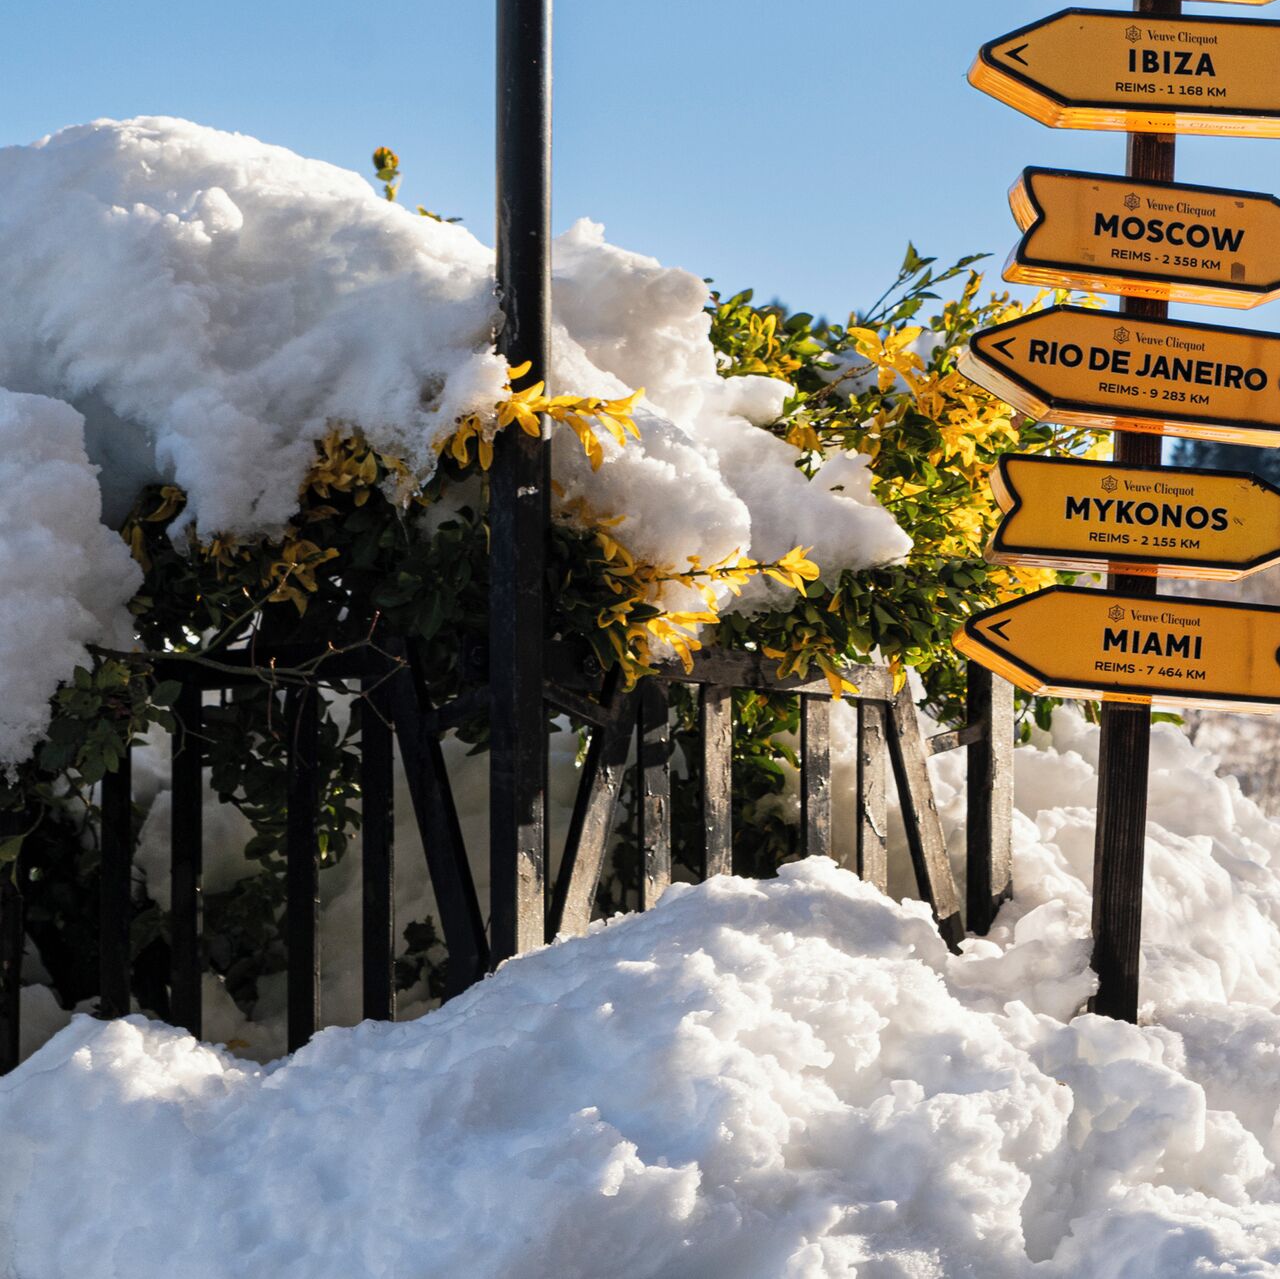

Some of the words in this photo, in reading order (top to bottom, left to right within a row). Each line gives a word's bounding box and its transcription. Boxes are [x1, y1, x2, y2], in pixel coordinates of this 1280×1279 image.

[1148, 30, 1176, 41] Veuve
[1178, 32, 1218, 46] Clicquot
[1129, 49, 1216, 76] IBIZA
[1116, 82, 1156, 93] REIMS
[1167, 84, 1175, 95] 1
[1179, 86, 1203, 96] 168
[1208, 87, 1226, 97] KM
[1146, 198, 1175, 212] Veuve
[1176, 202, 1216, 217] Clicquot
[1094, 213, 1244, 252] MOSCOW
[1111, 249, 1151, 262] REIMS
[1161, 254, 1170, 265] 2
[1174, 256, 1197, 267] 358
[1202, 260, 1220, 270] KM
[1136, 332, 1164, 346] Veuve
[1166, 337, 1205, 352] Clicquot
[1029, 339, 1083, 367] RIO
[1089, 347, 1130, 374] DE
[1135, 354, 1267, 391] JANEIRO
[1099, 382, 1139, 396] REIMS
[1149, 388, 1159, 399] 9
[1162, 390, 1185, 402] 283
[1190, 394, 1209, 404] KM
[1124, 480, 1152, 492] Veuve
[1154, 483, 1195, 497] Clicquot
[1066, 496, 1228, 531] MYKONOS
[1090, 532, 1129, 544] REIMS
[1140, 535, 1149, 546] 2
[1153, 537, 1176, 547] 155
[1181, 539, 1200, 549] KM
[1131, 610, 1159, 622] Veuve
[1161, 613, 1201, 627] Clicquot
[1104, 628, 1202, 659] MIAMI
[1095, 661, 1135, 673] REIMS
[1146, 665, 1155, 676] 7
[1158, 667, 1182, 678] 464
[1186, 670, 1206, 680] KM
